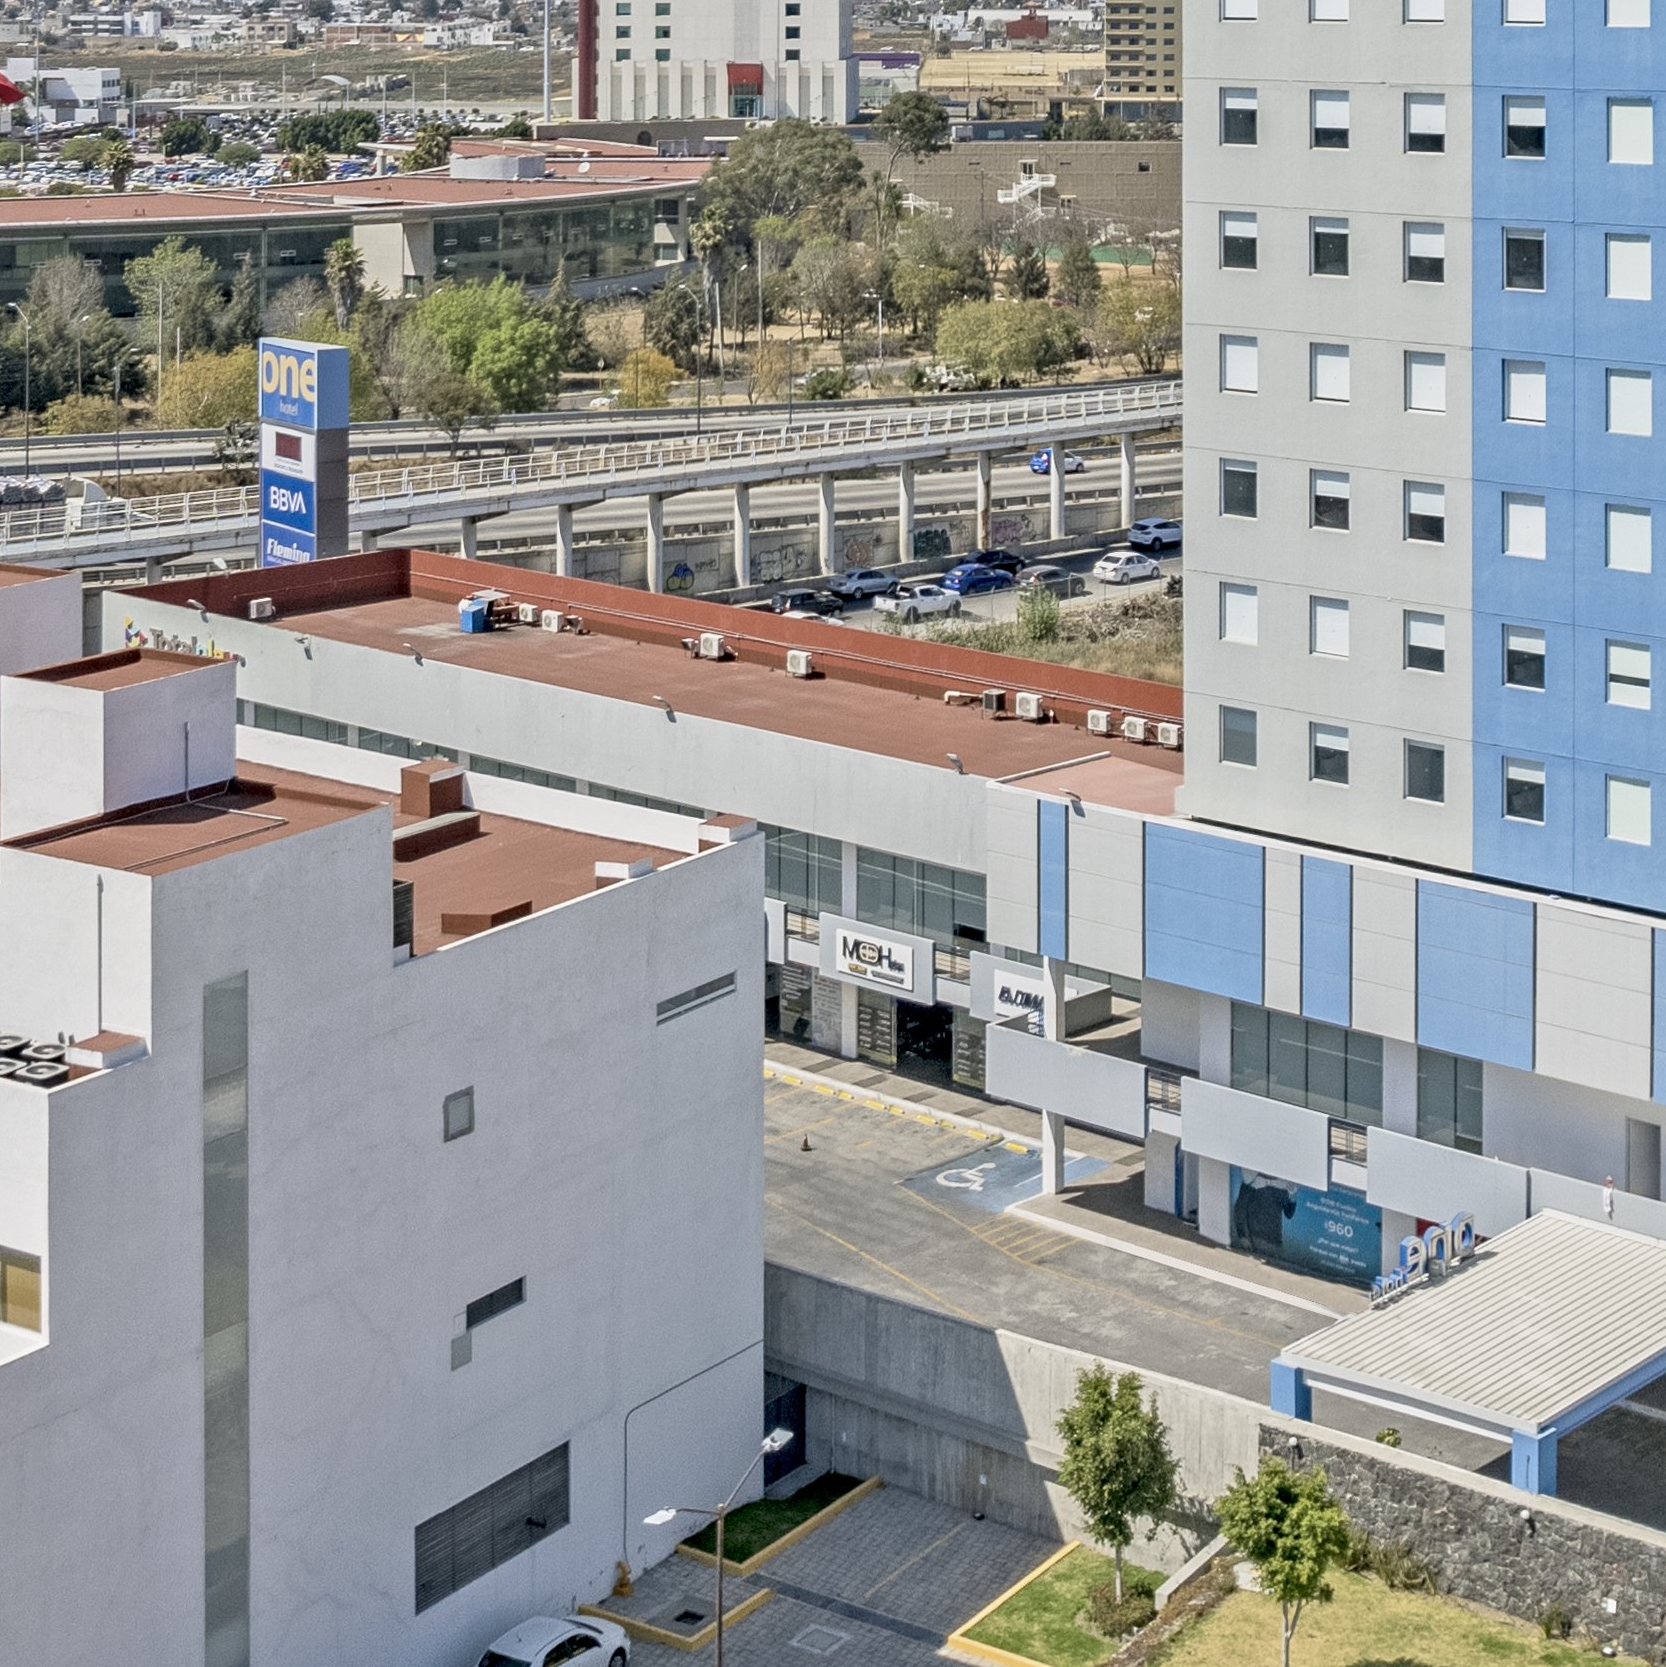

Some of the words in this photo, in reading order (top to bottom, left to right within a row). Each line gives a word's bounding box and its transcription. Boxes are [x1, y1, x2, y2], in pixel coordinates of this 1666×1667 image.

[262, 350, 315, 403] one
[279, 399, 299, 416] hotel
[270, 485, 306, 514] BBVA
